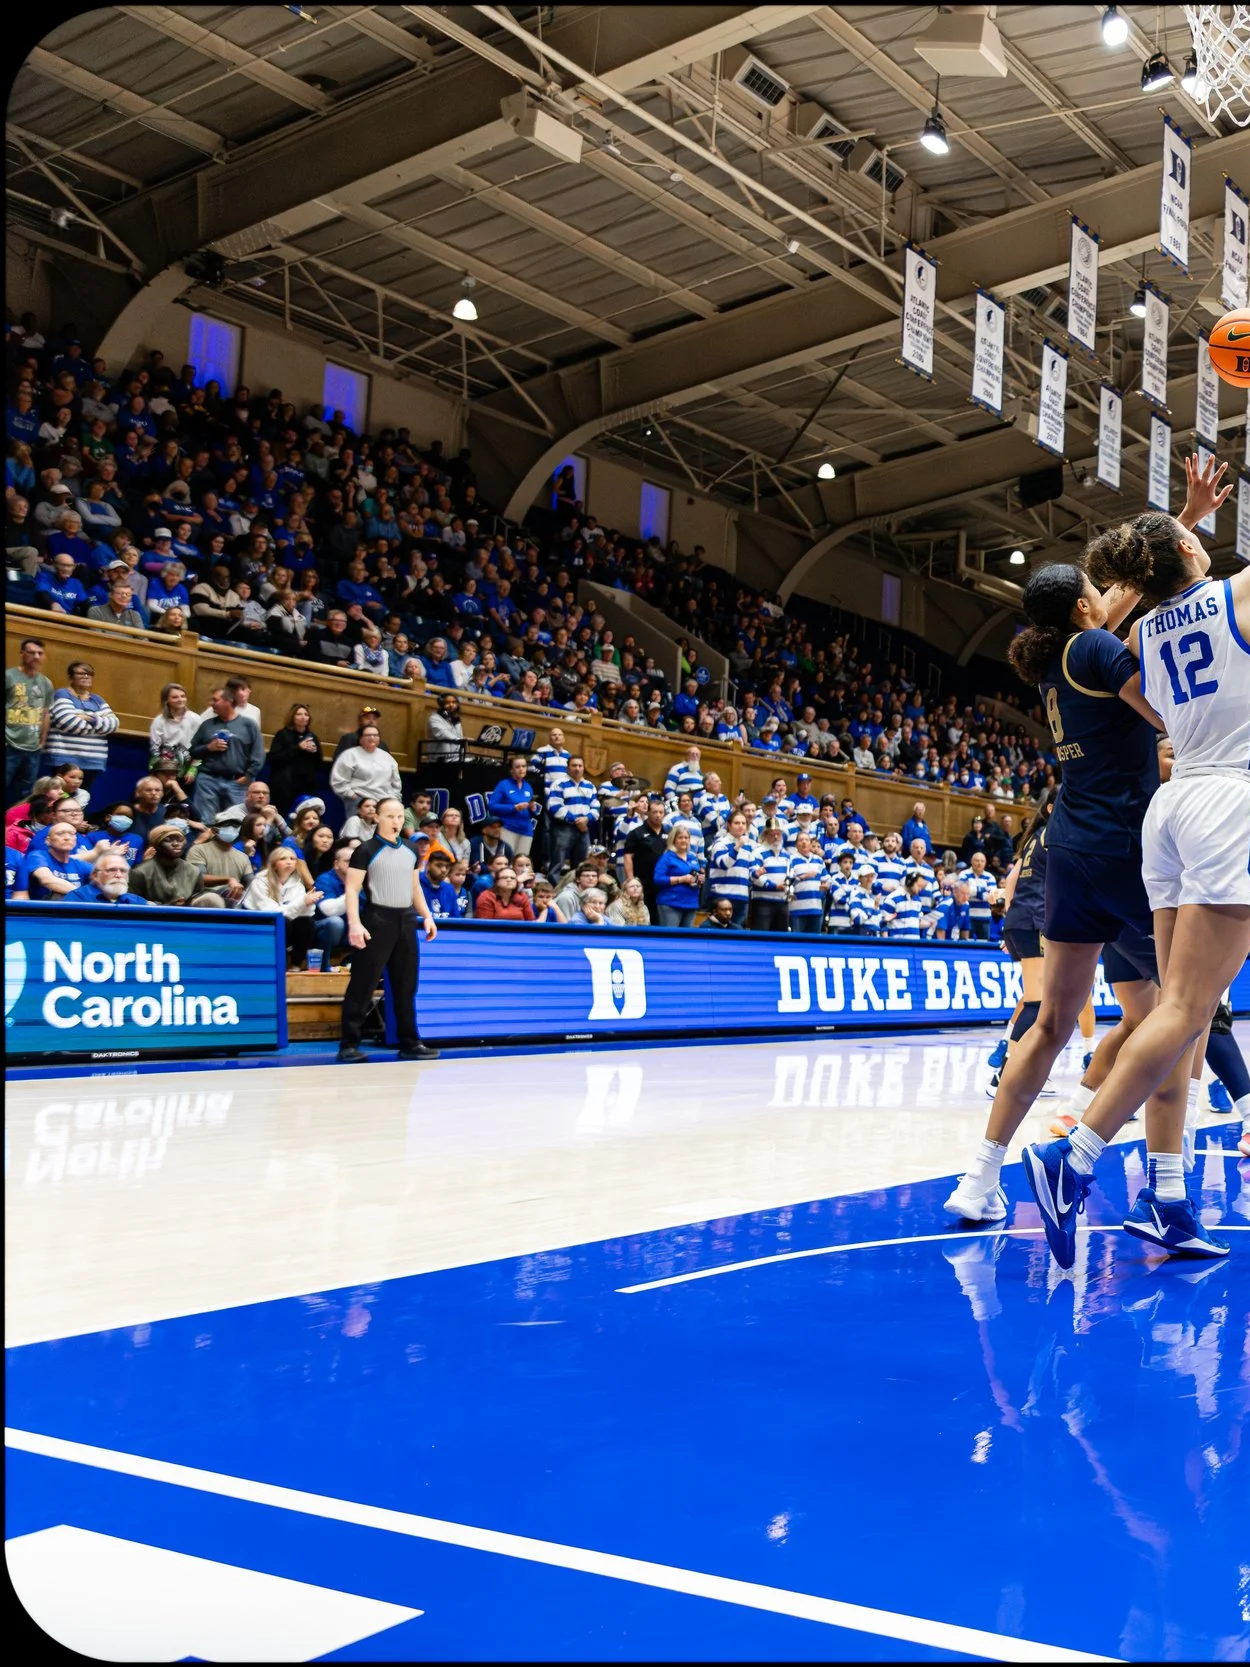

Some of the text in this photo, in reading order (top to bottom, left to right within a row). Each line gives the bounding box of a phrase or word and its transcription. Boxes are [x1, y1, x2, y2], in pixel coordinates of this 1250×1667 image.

[1146, 597, 1219, 638] THOMAS
[1159, 631, 1218, 706] 12
[43, 942, 181, 984] North
[583, 948, 647, 1021] D
[774, 956, 913, 1013] DUKE
[42, 985, 240, 1030] Carolina
[92, 1051, 139, 1059] DAKTRONICS
